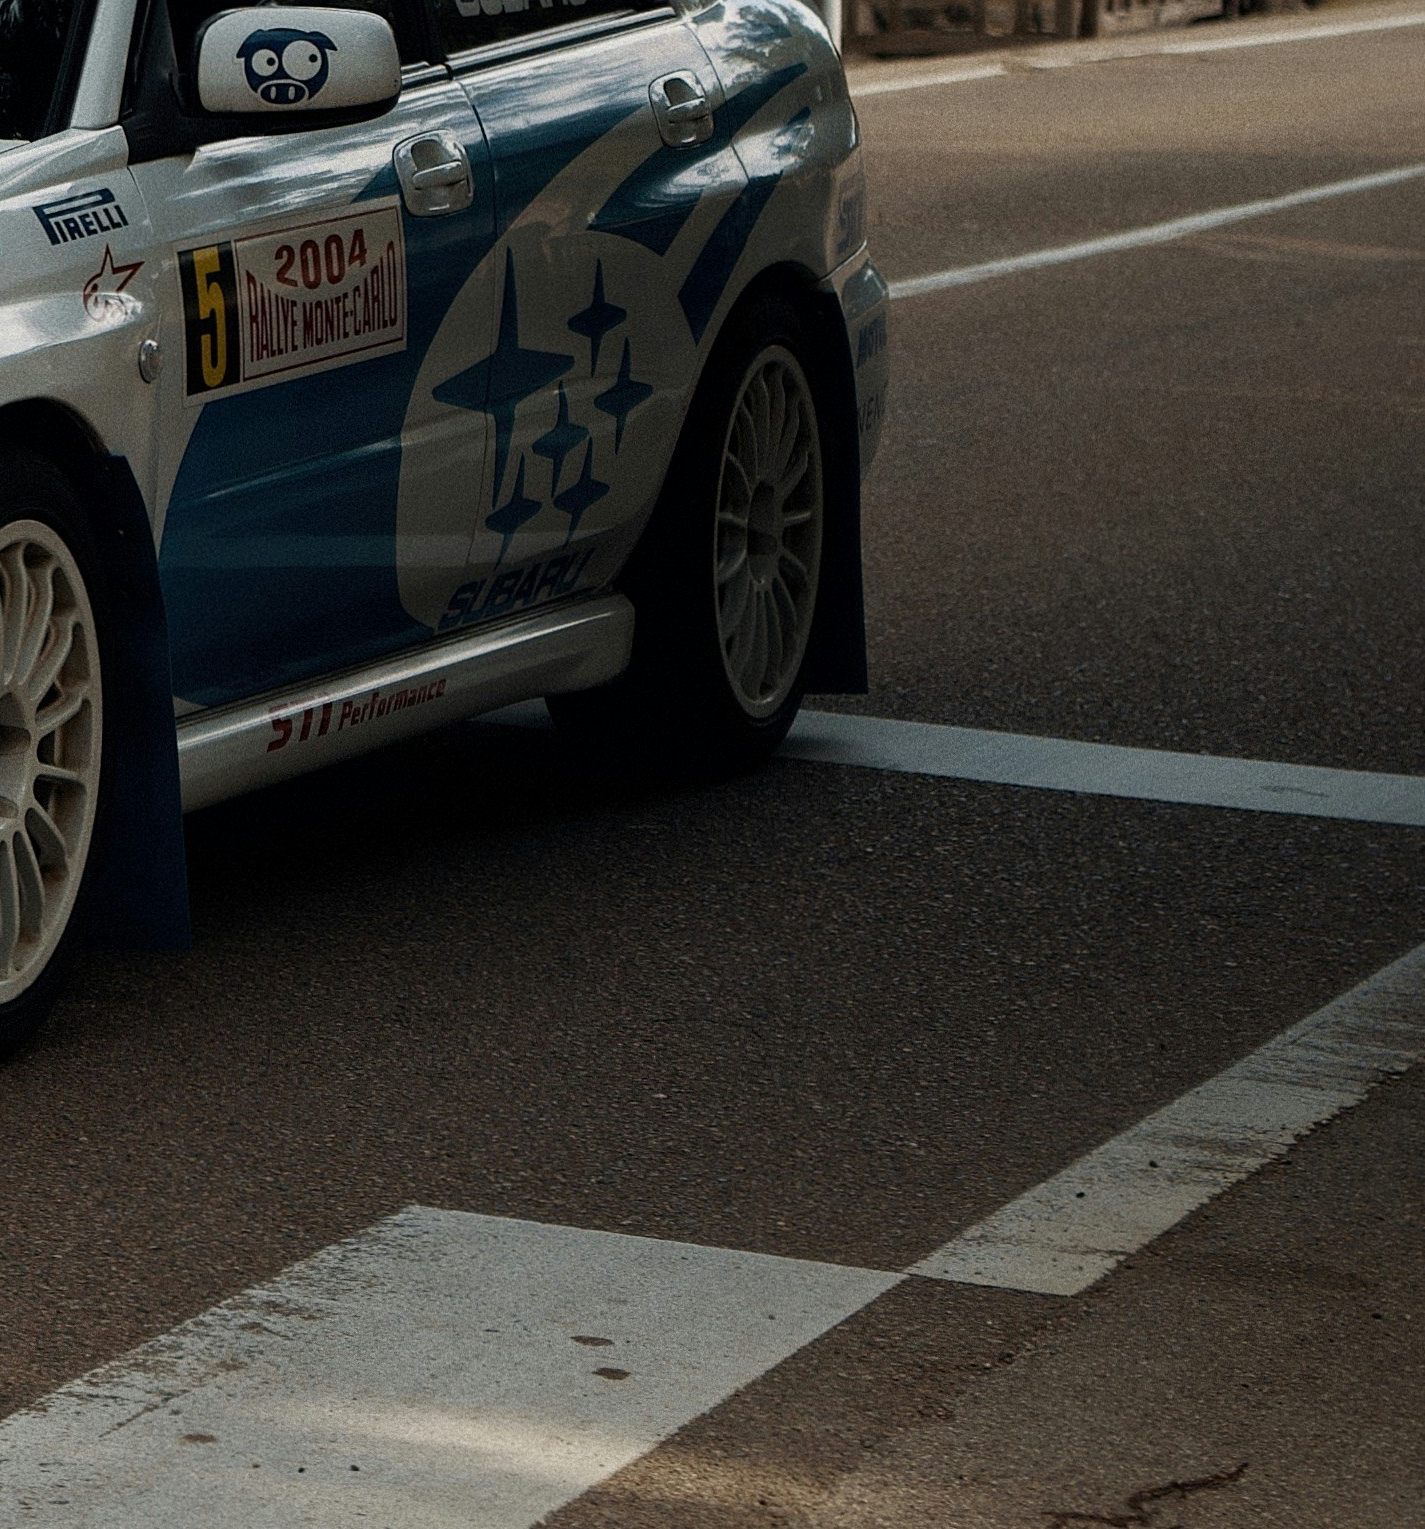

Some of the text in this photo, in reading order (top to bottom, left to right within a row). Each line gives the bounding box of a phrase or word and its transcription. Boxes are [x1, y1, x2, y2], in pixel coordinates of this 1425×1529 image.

[33, 187, 129, 245] PIRELLI
[274, 229, 367, 289] 2004
[192, 247, 228, 388] 5
[246, 240, 397, 362] RALLYE MONTE-CARLO
[438, 547, 595, 630] SUBARU
[267, 679, 446, 753] STI Performance
